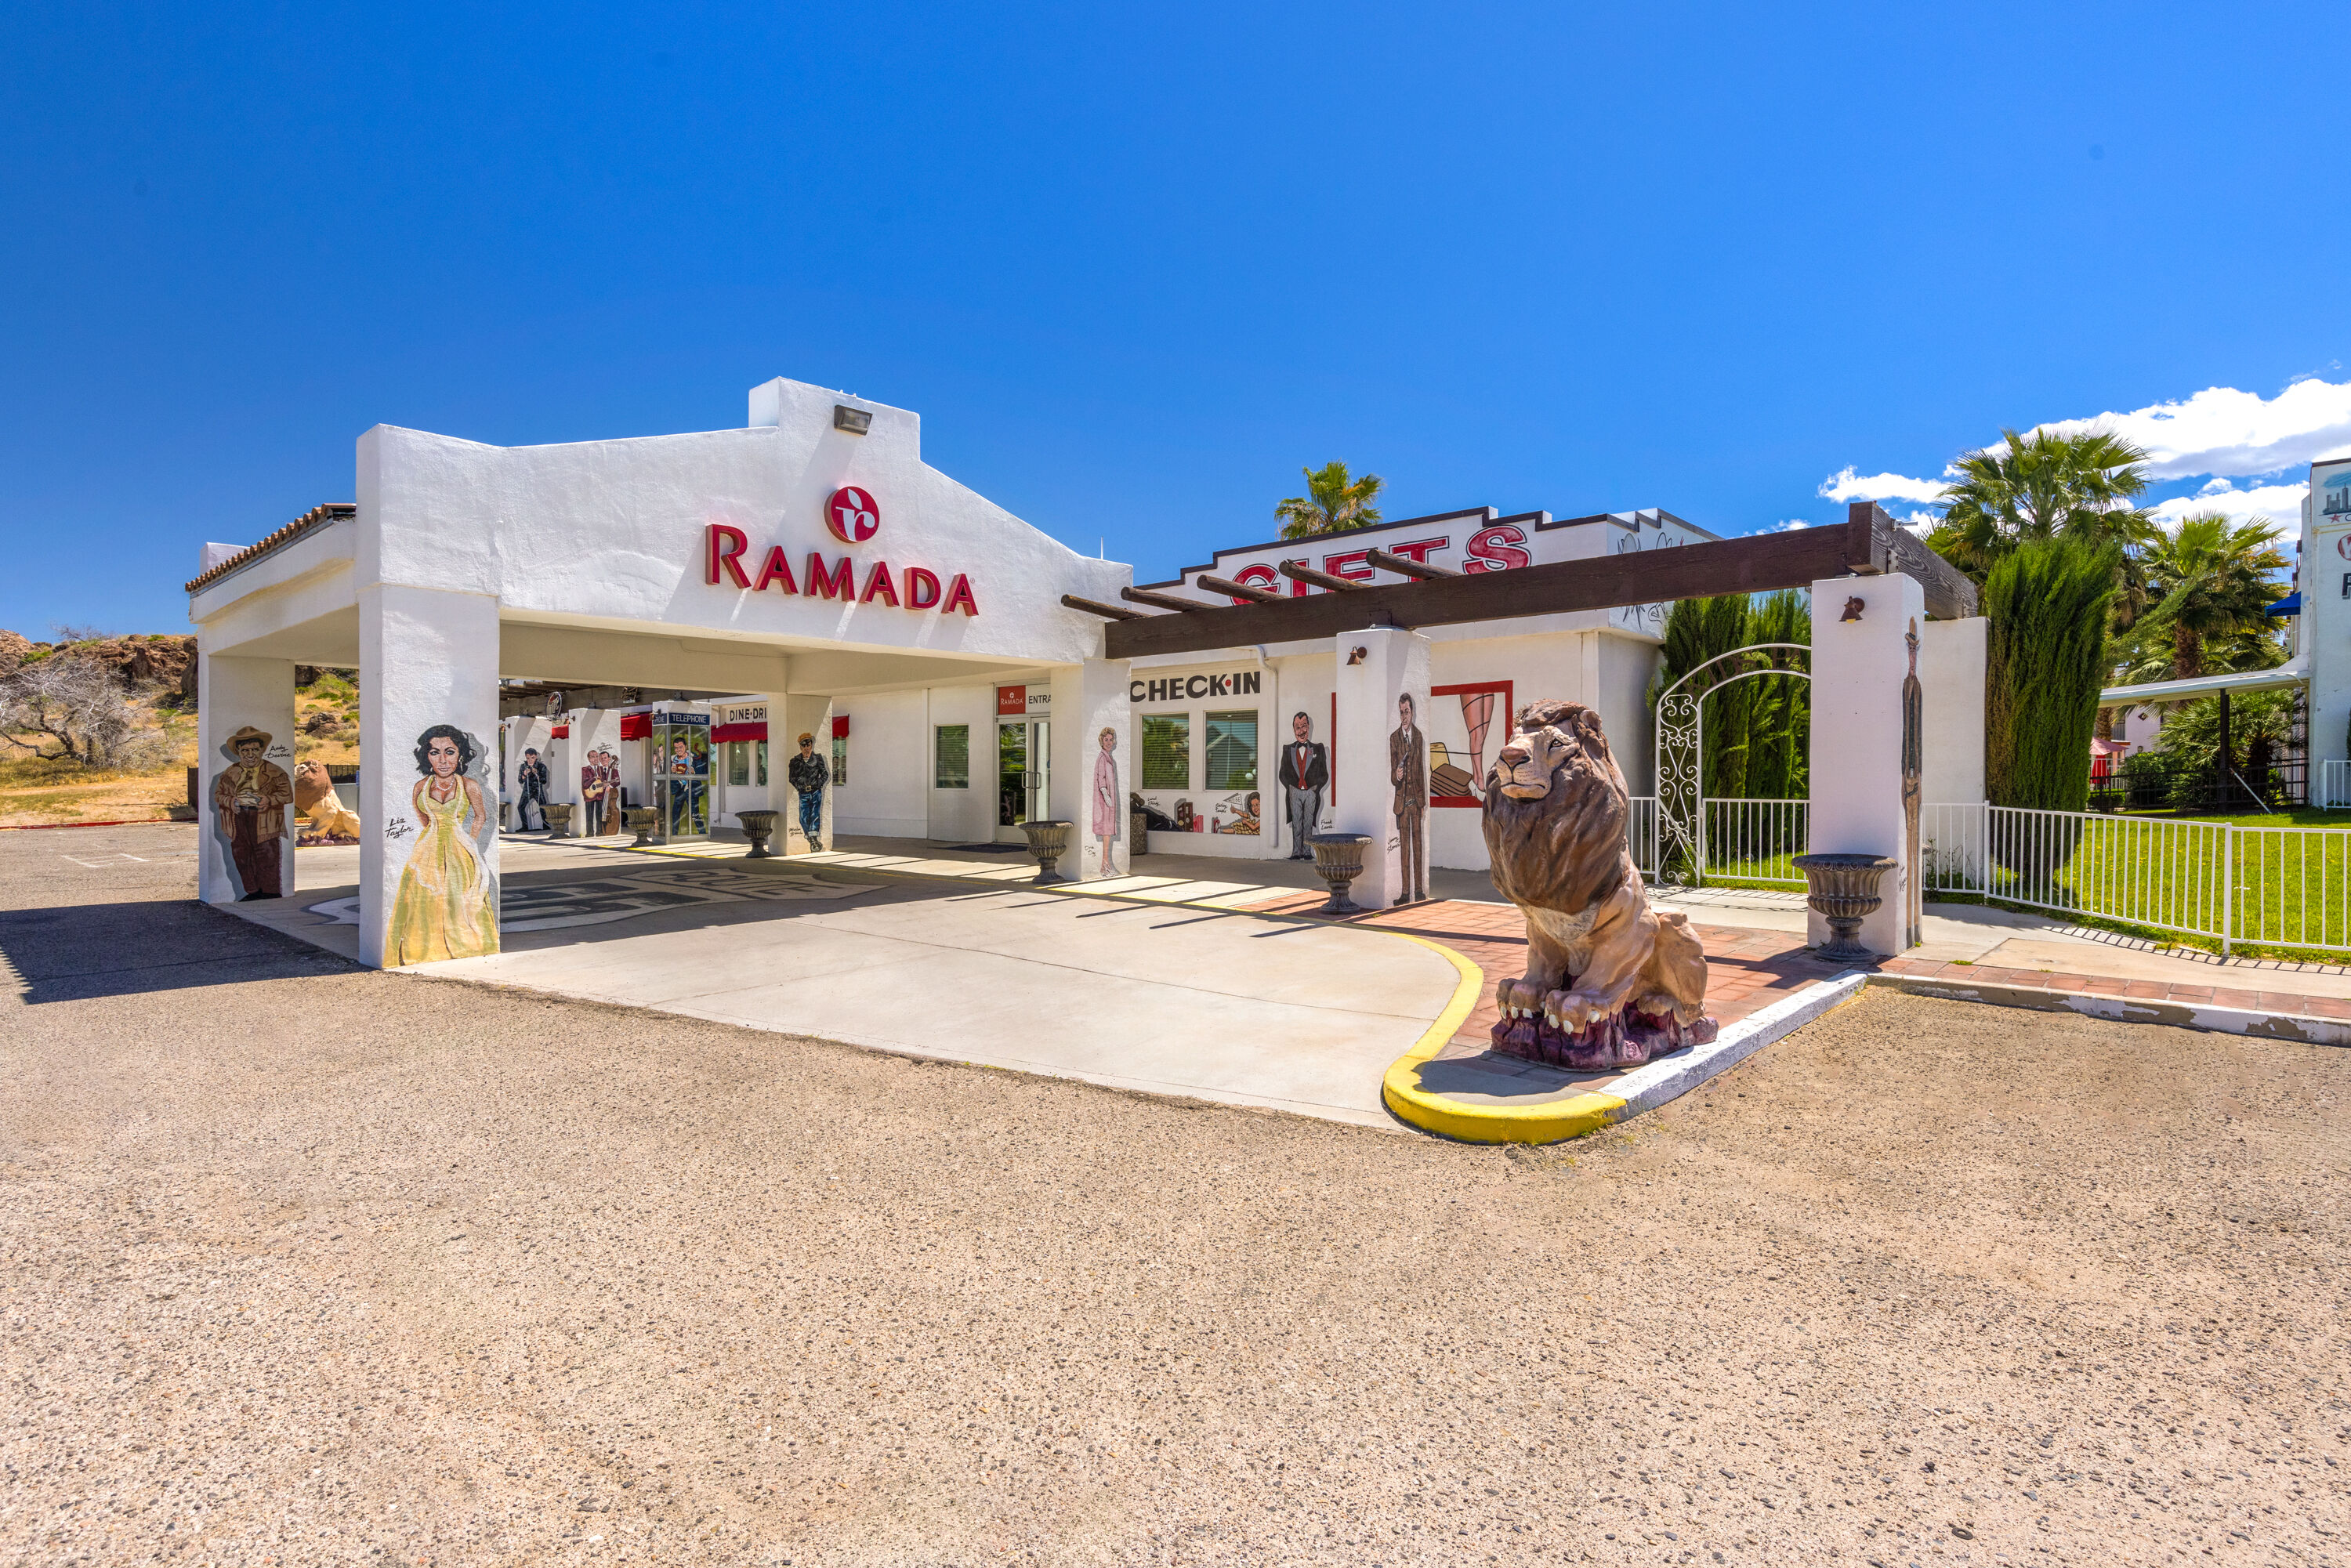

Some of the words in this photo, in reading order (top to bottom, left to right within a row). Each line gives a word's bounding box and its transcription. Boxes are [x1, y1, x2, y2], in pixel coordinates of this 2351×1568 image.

[705, 523, 980, 617] RAMADA
[1230, 524, 1532, 607] GIFTS
[1028, 694, 1051, 704] ENTRA
[672, 714, 707, 723] TELEPHONE
[389, 817, 406, 827] Liz
[384, 825, 414, 838] Taylor
[643, 871, 843, 896] ROUTE
